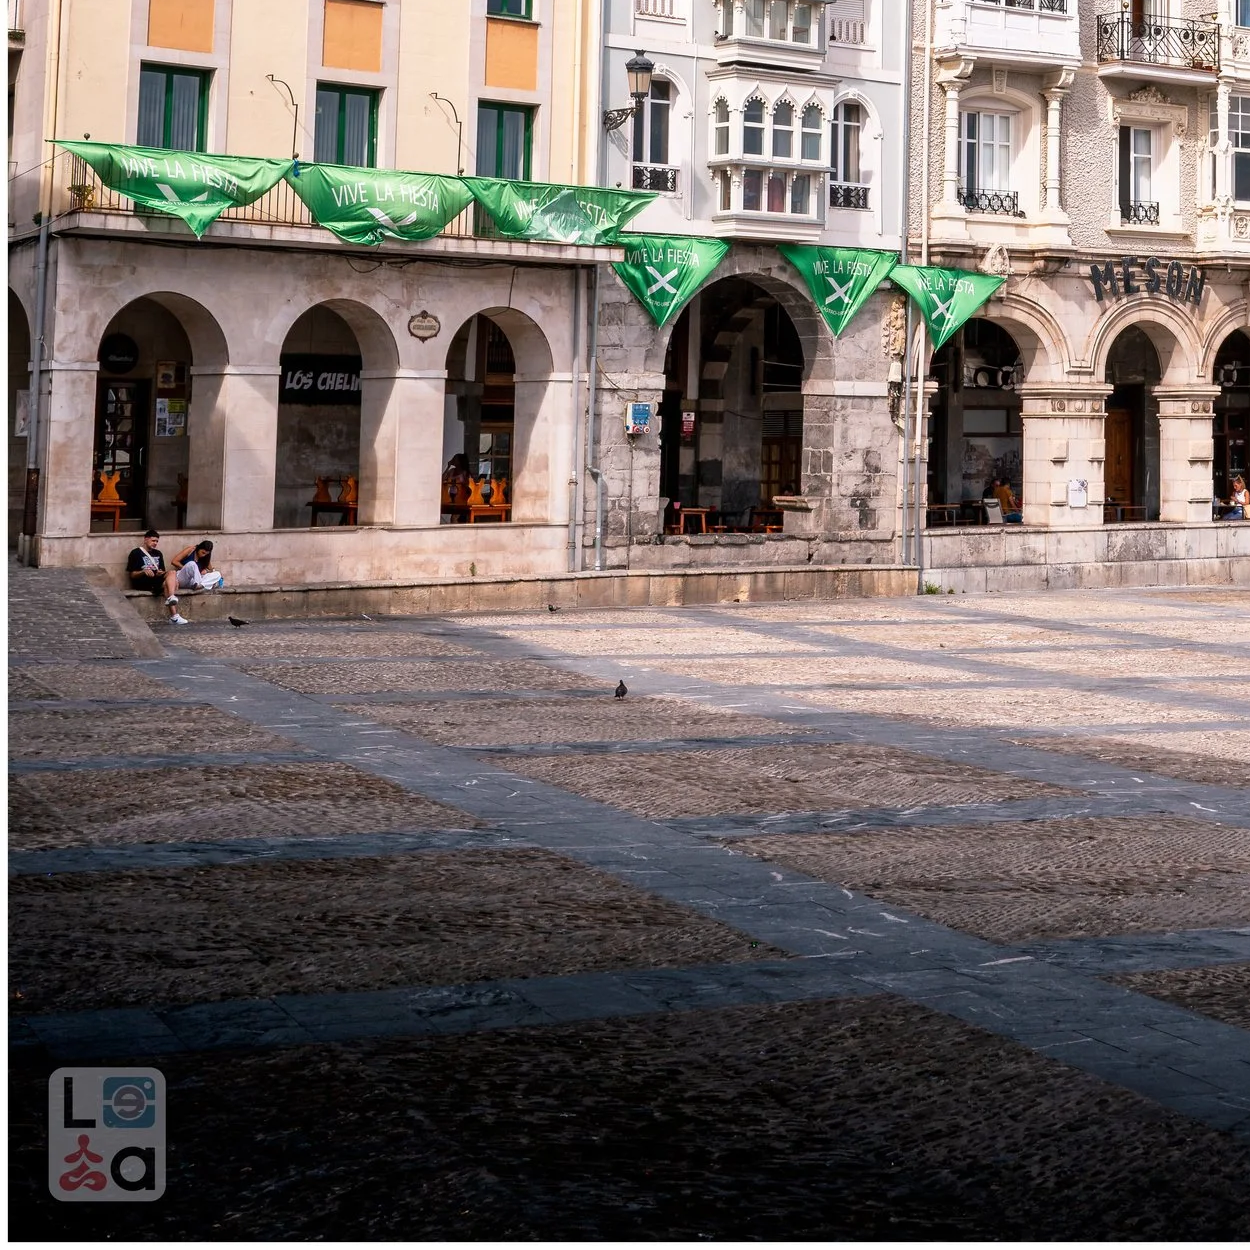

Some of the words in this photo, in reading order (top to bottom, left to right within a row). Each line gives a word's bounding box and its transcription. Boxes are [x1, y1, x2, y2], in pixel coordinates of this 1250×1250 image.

[121, 157, 159, 179] VIVE
[164, 158, 186, 179] LA
[190, 163, 239, 196] FIESTA
[331, 181, 368, 207] VIVE
[374, 181, 395, 202] LA
[399, 183, 439, 214] FIESTA
[627, 248, 648, 265] VIVE
[652, 248, 664, 263] LA
[667, 248, 700, 268] FIESTA
[833, 259, 844, 274] LA
[934, 277, 945, 291] LA
[1090, 256, 1206, 306] MESON
[285, 370, 314, 390] LOS
